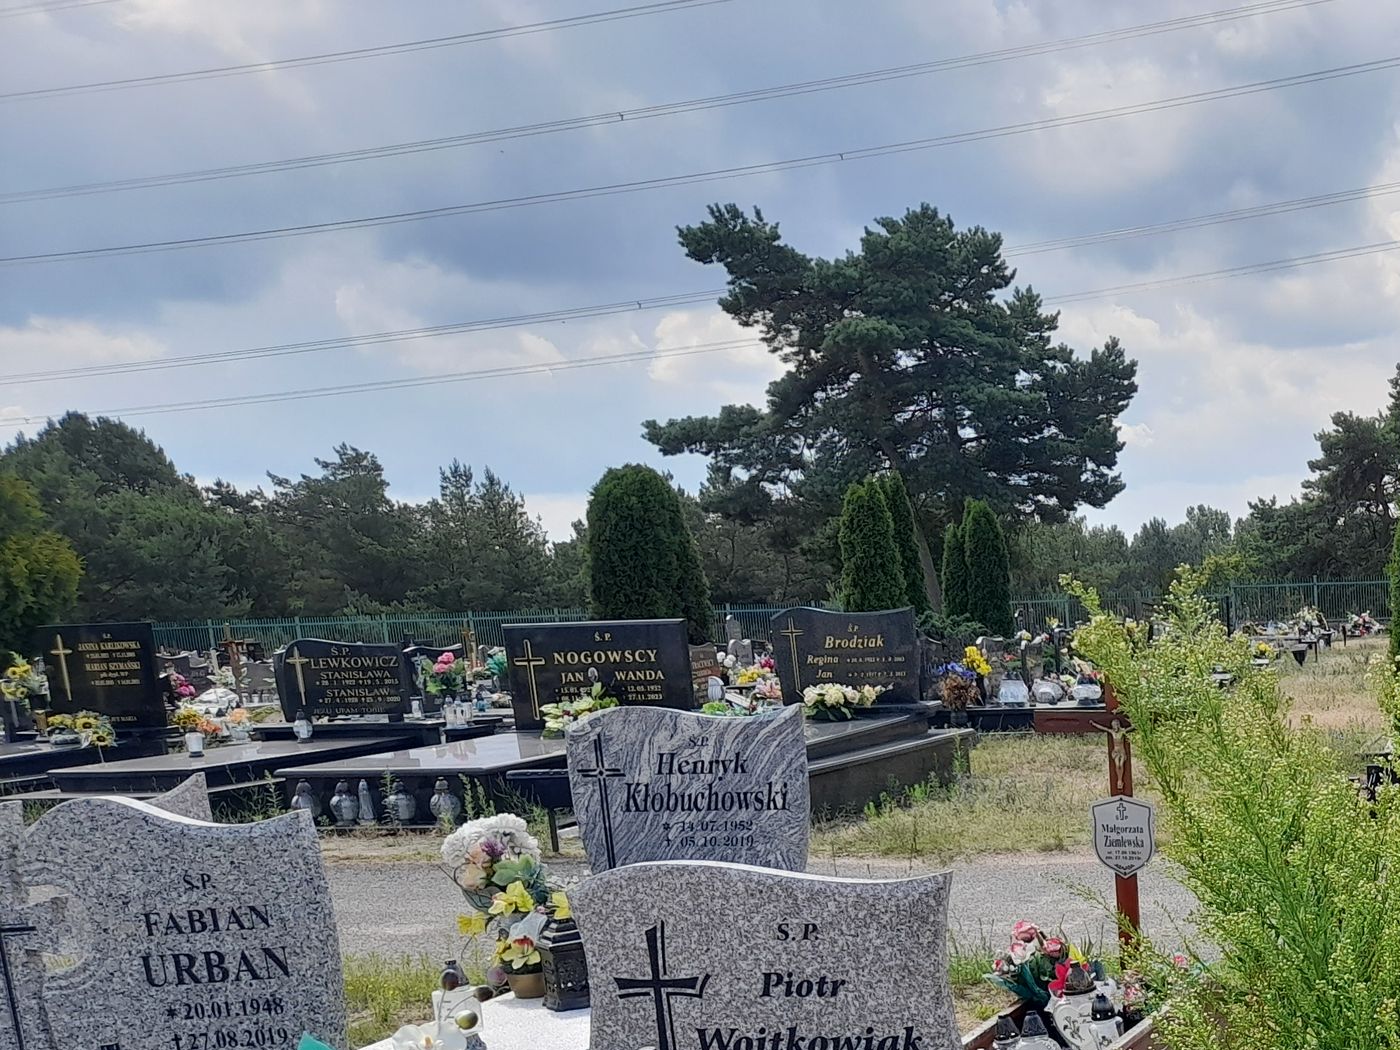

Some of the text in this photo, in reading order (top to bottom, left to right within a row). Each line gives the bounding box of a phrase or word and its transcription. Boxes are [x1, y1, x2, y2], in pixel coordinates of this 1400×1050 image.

[824, 633, 884, 649] Brodziak
[310, 656, 399, 669] LEWKOWICZ
[552, 649, 658, 665] NOGOWSCY
[806, 654, 839, 665] Regina
[560, 670, 665, 684] JAN WANDA
[815, 669, 833, 679] Jan
[656, 751, 750, 781] Henryk
[622, 781, 791, 813] Kłobuchowski
[143, 904, 272, 937] FABIAN
[140, 946, 292, 988] URBAN
[760, 971, 846, 998] Piotr
[183, 1000, 285, 1021] 20.01.1948
